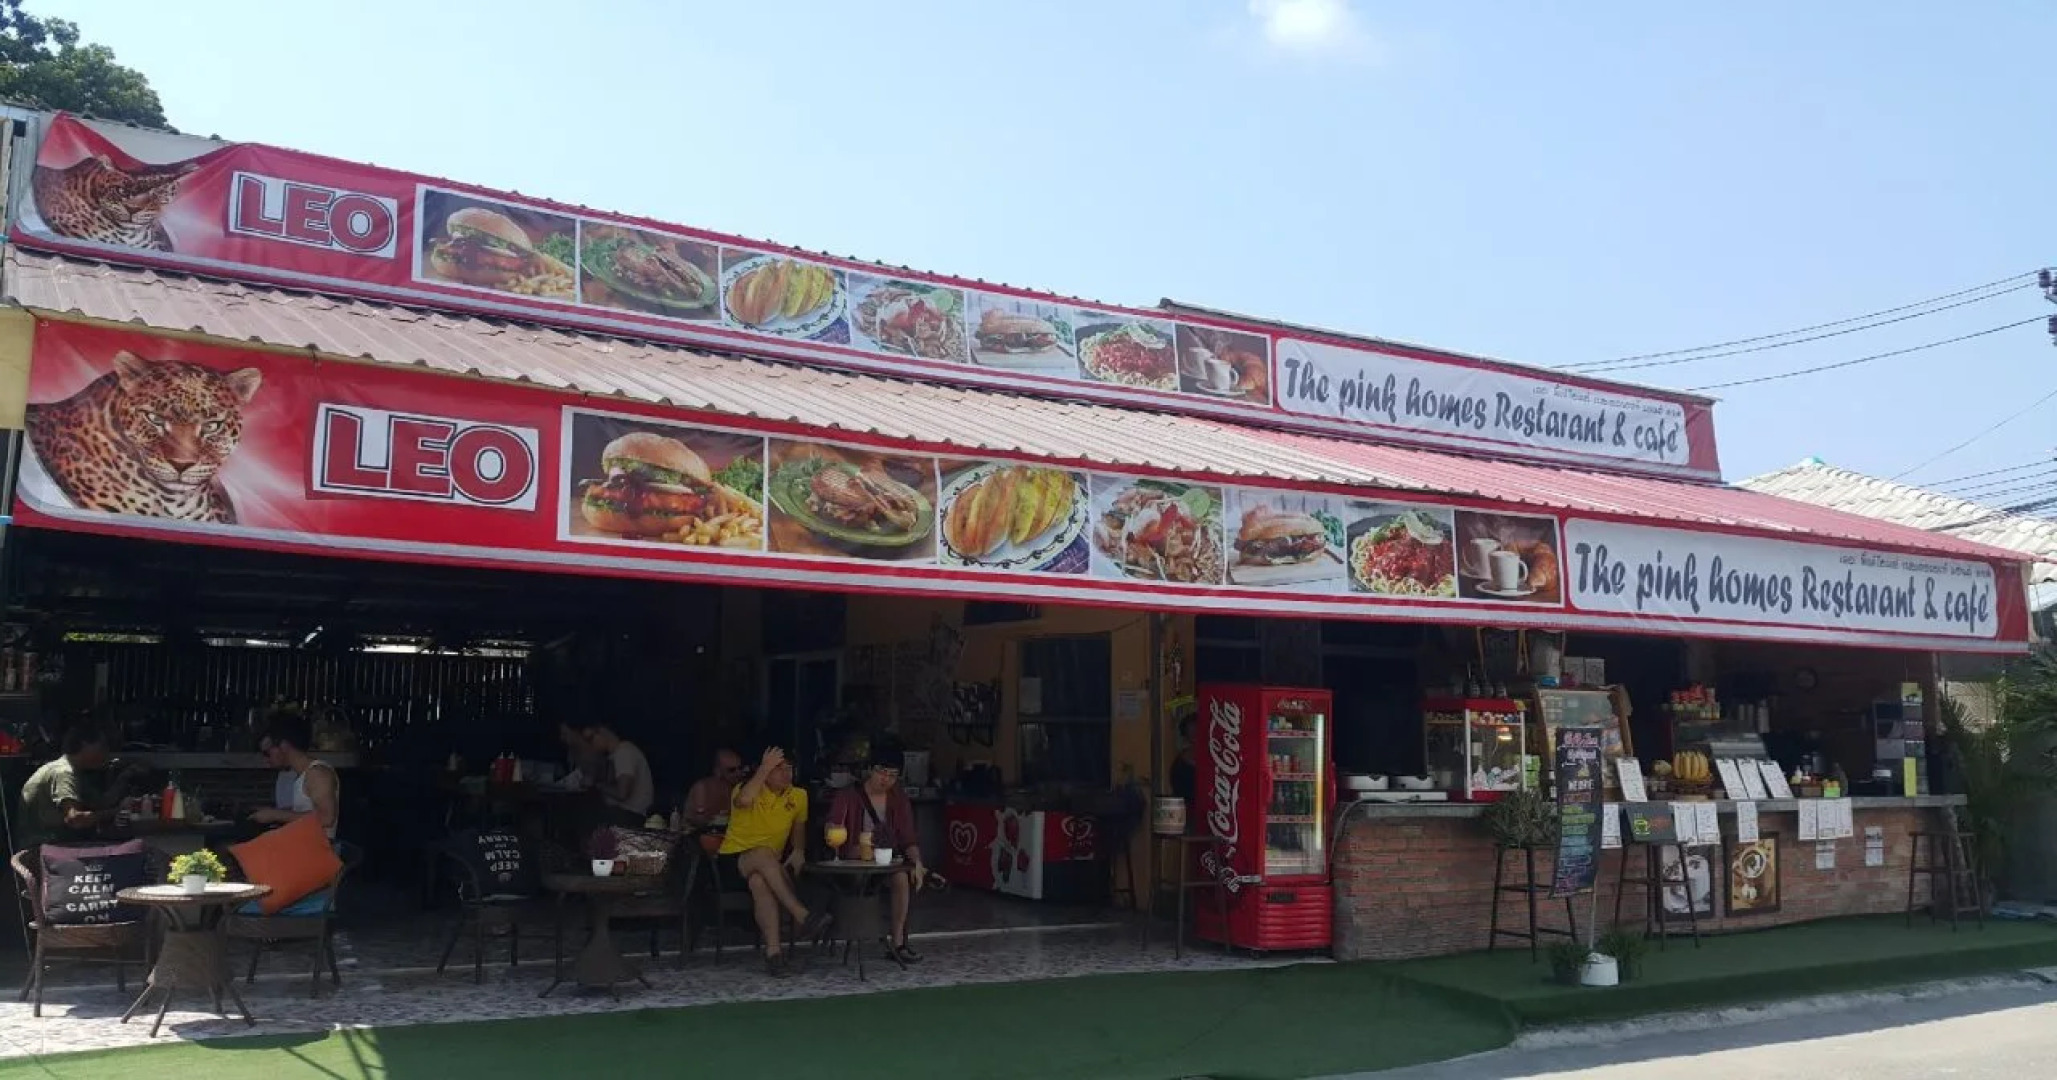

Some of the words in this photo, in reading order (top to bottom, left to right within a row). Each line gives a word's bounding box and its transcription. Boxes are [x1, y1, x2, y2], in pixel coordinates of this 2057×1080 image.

[235, 174, 393, 252] LEO
[1285, 358, 1329, 403] The
[1339, 369, 1397, 423] pink
[1406, 377, 1487, 430] homes
[1494, 391, 1605, 443] Restarant
[1612, 411, 1626, 447] &
[1634, 418, 1680, 460] café
[320, 407, 535, 505] LEO
[1575, 542, 1626, 595] The
[1636, 550, 1700, 614] pink
[1709, 555, 1792, 614] homes
[1802, 565, 1915, 618] Restarant
[1924, 576, 1938, 620] &
[1945, 579, 1990, 633] café
[66, 899, 118, 912] CARRY
[68, 884, 114, 894] CALM
[74, 874, 111, 883] KEEP
